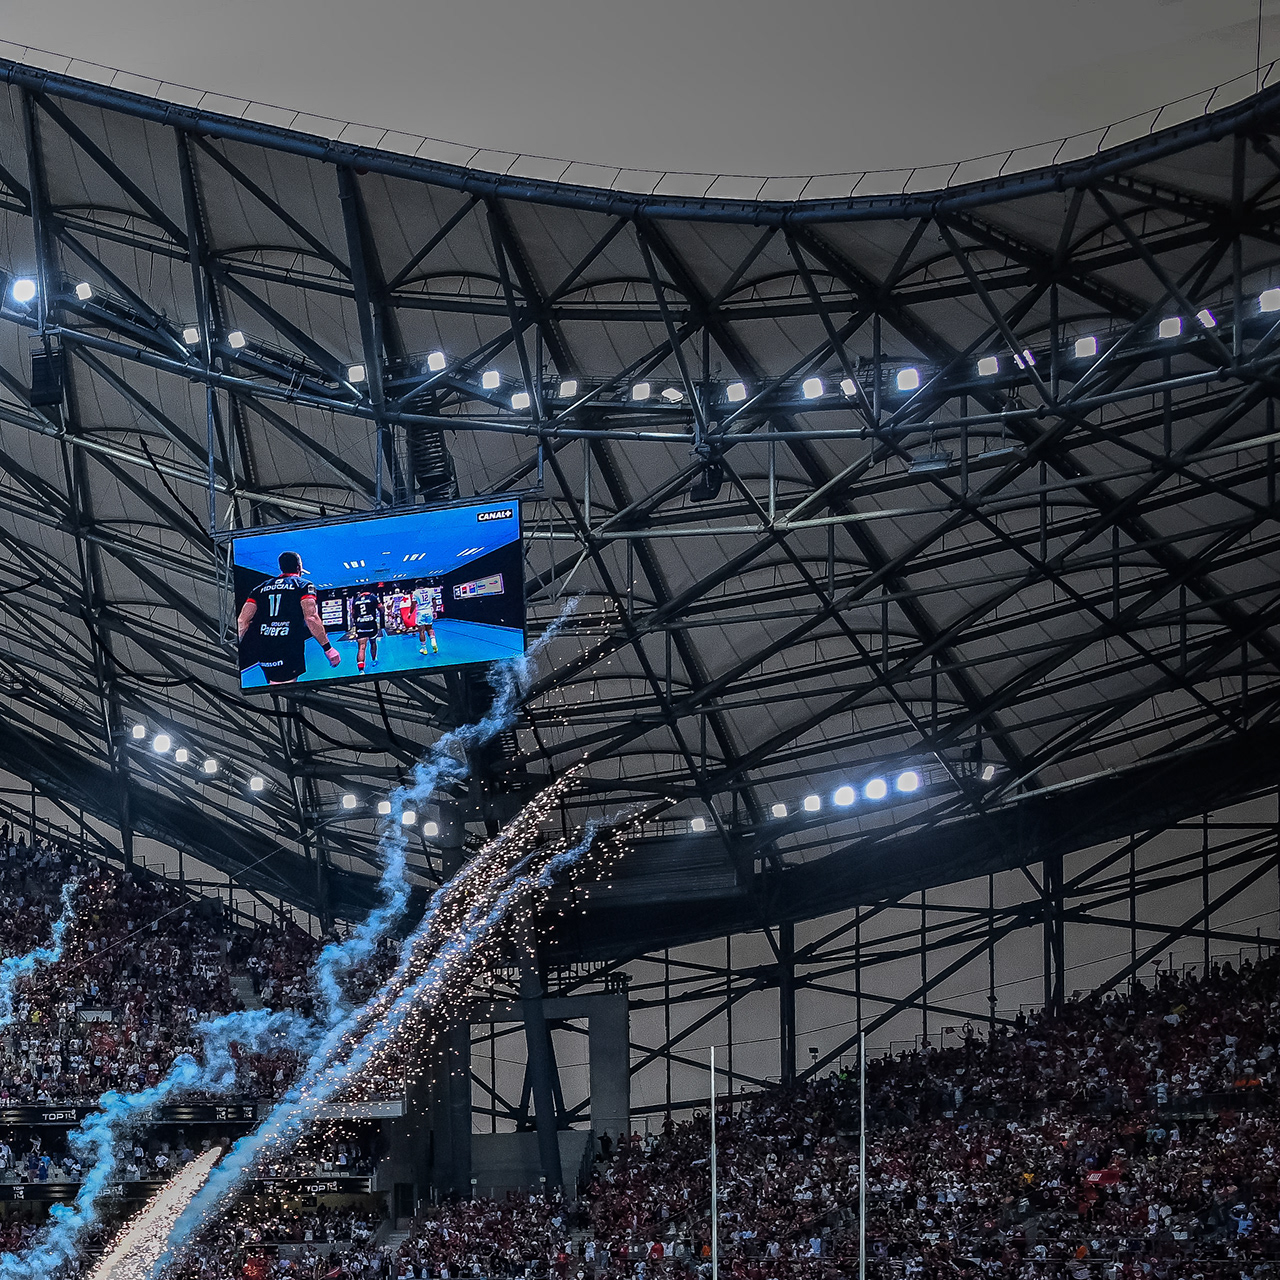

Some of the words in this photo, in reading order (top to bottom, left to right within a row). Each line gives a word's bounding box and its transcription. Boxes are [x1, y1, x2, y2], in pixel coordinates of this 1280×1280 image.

[478, 510, 512, 521] CANAL+
[260, 584, 295, 593] FIDUCIAL
[42, 1110, 77, 1121] TOP14
